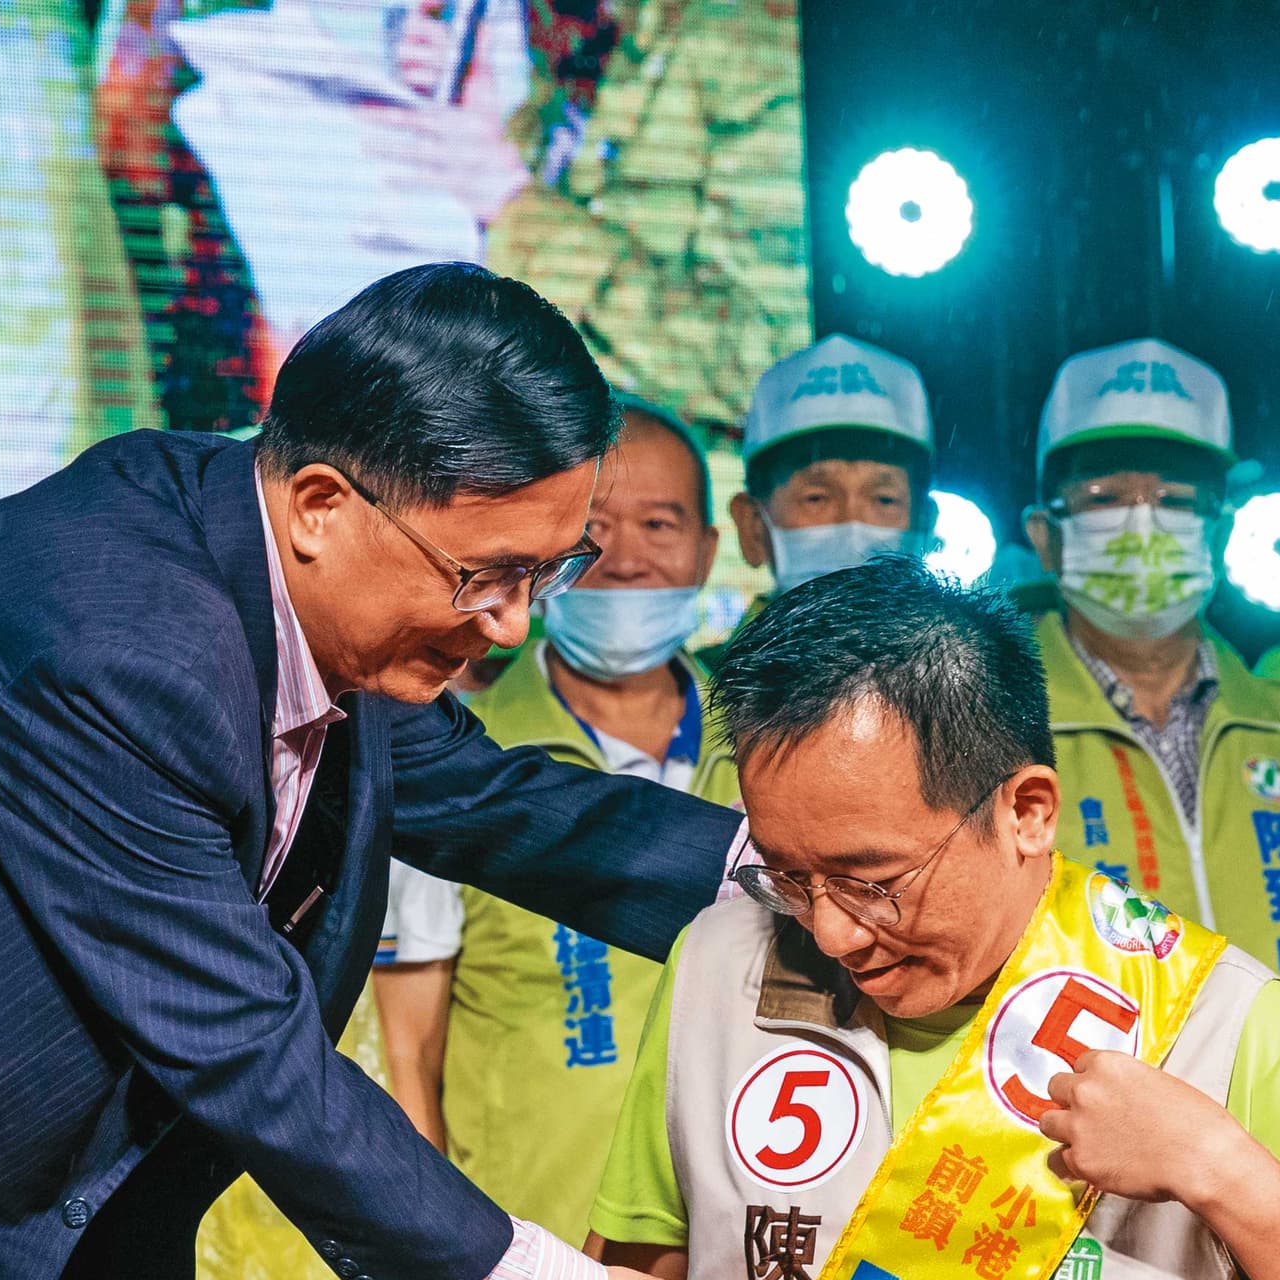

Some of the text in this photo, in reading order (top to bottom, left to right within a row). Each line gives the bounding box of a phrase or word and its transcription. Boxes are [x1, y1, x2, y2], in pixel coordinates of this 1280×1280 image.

[1001, 976, 1140, 1123] 5
[754, 1070, 831, 1170] 5
[899, 1144, 989, 1251] 前鎮
